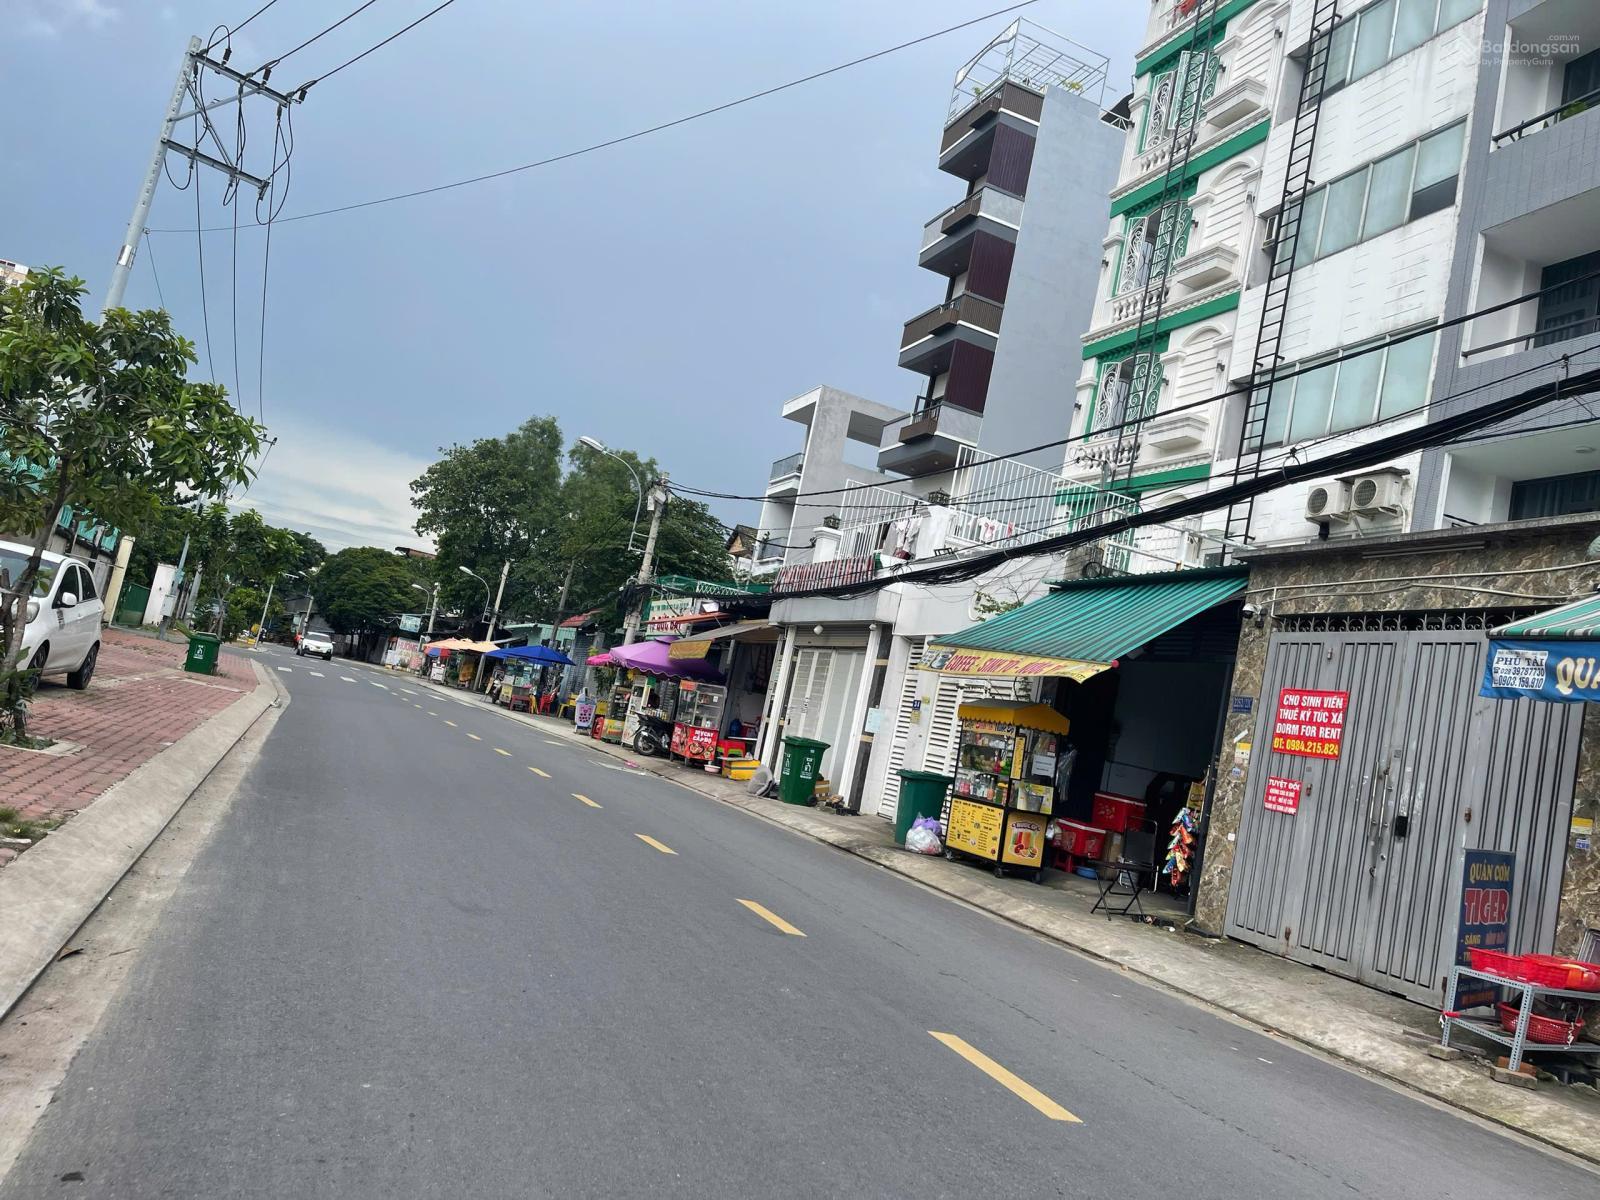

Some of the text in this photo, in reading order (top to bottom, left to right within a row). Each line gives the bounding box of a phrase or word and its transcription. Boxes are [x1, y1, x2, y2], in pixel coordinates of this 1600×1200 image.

[945, 654, 981, 672] COFFEE
[1283, 694, 1344, 709] CHO SINH VIÊN
[1279, 707, 1343, 724] THUÊ KÝ TÚC XÁ
[1276, 723, 1342, 740] DORM FOR RENT
[1285, 739, 1339, 756] 0984.215.824
[1268, 778, 1288, 789] TUYỆT
[1464, 887, 1510, 926] TIGER
